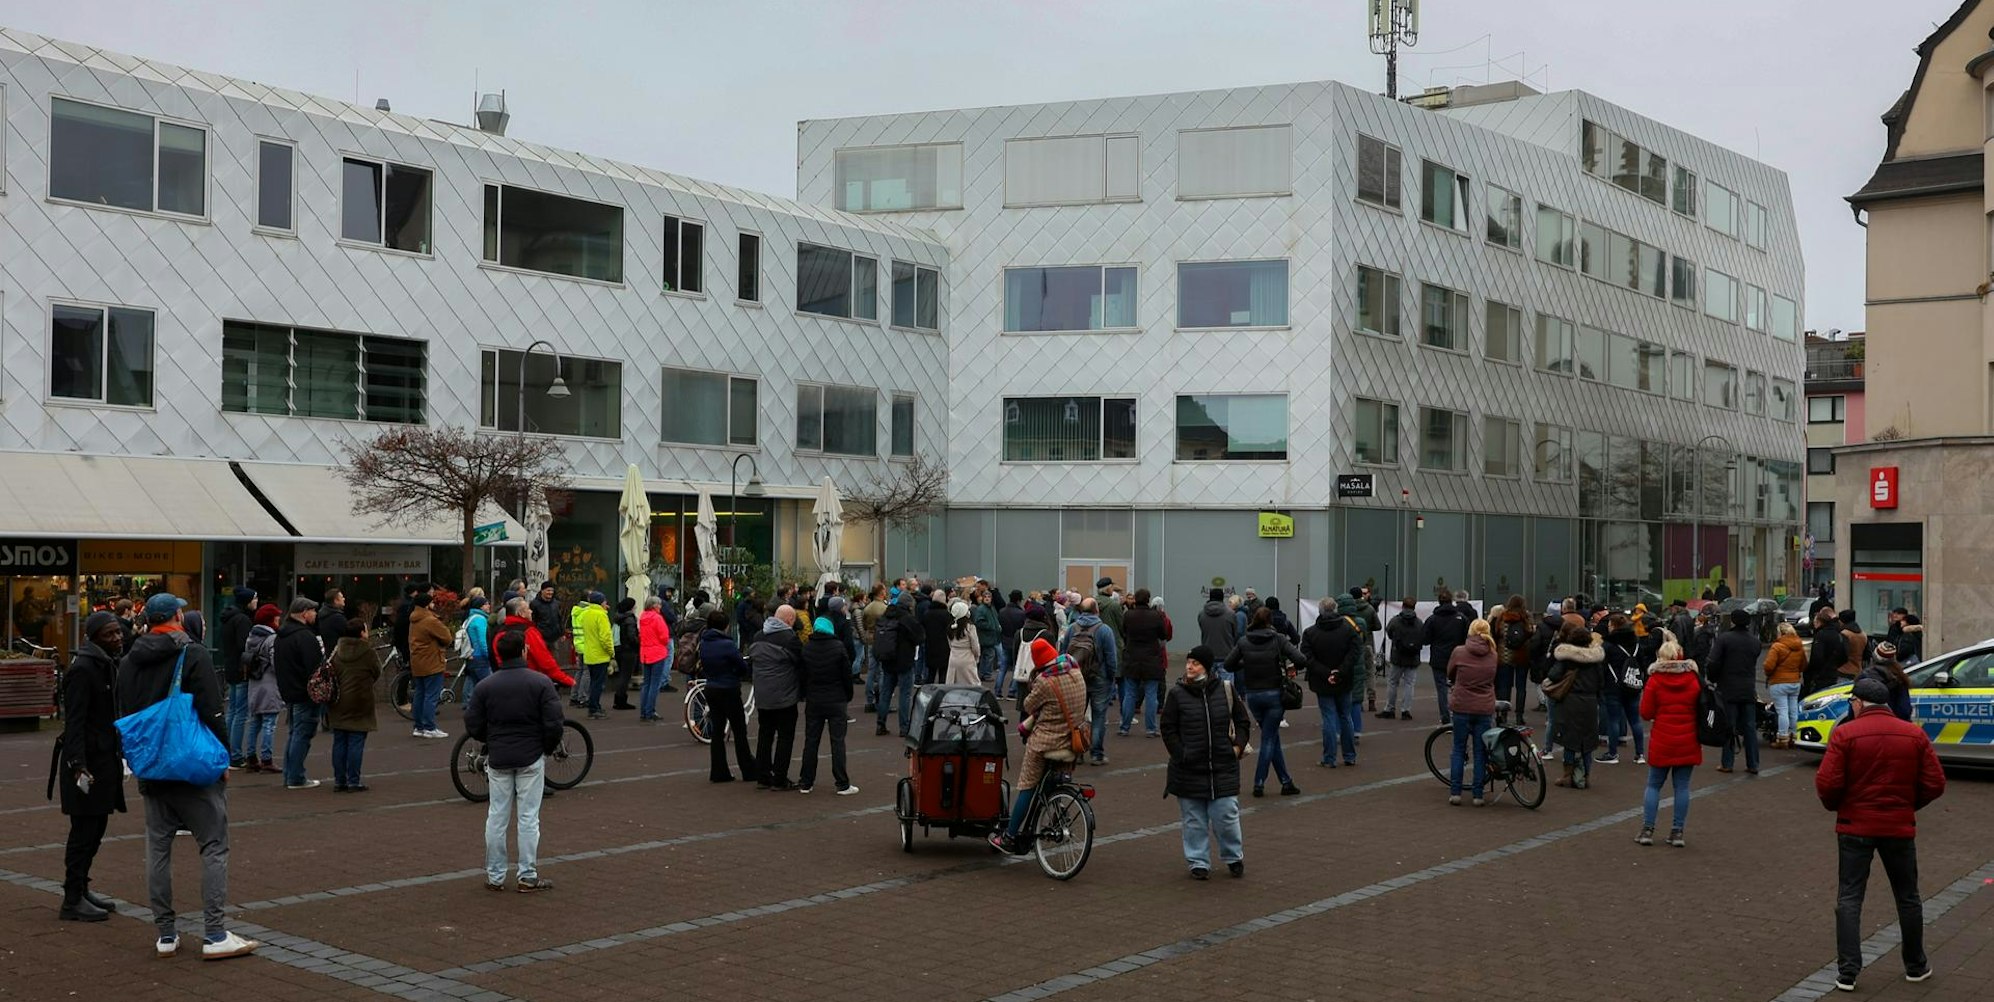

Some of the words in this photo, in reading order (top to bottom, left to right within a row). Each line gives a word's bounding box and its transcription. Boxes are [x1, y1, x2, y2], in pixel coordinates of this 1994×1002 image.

[1340, 482, 1370, 490] MASALA
[83, 552, 124, 560] BIKES
[133, 552, 169, 560] MORE
[338, 560, 396, 569] RESTAURANT
[404, 560, 421, 568] BAR
[1931, 703, 1994, 716] POLIZEI
